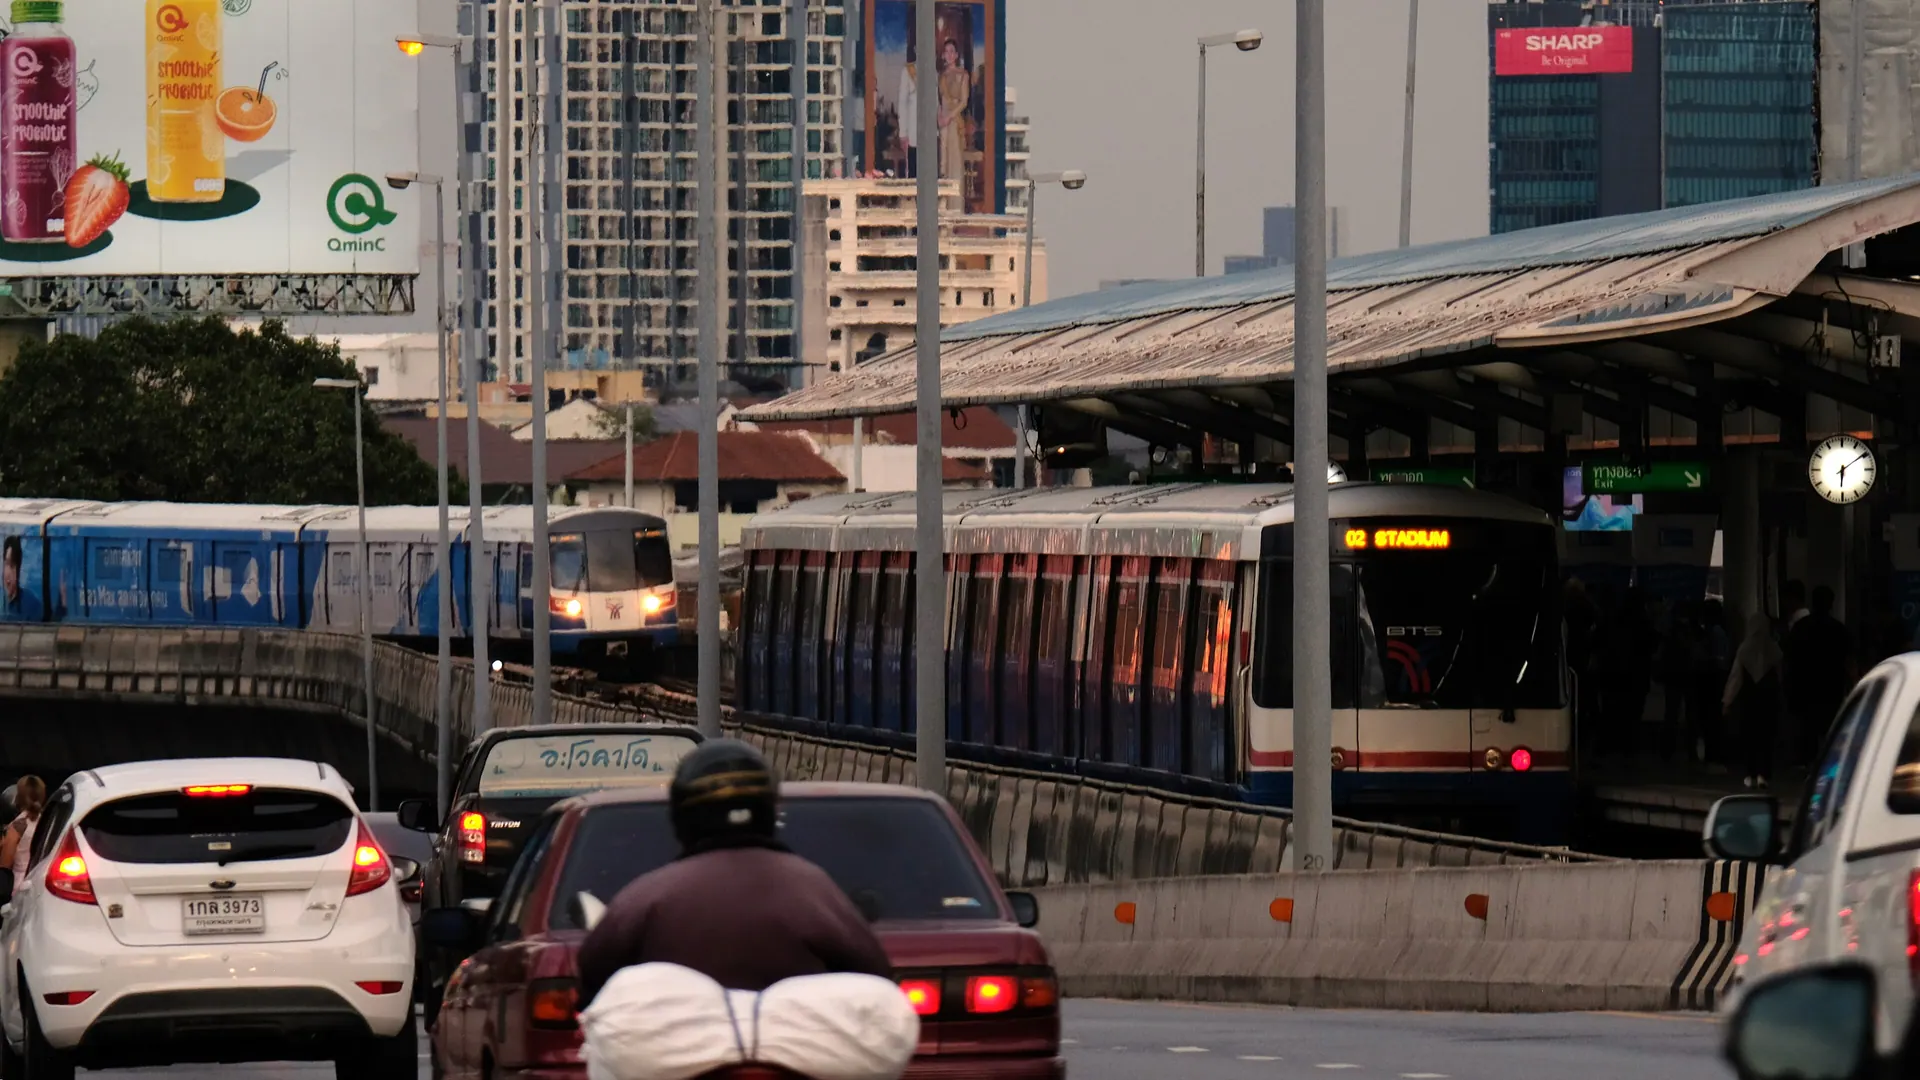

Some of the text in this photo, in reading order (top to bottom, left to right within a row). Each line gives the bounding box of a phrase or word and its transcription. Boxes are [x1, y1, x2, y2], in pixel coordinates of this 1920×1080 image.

[1526, 34, 1604, 51] SHARP
[1541, 55, 1552, 66] Be
[327, 236, 386, 252] QminC
[1594, 478, 1614, 489] Exit
[1345, 530, 1450, 548] 02 STADIUM
[1386, 625, 1443, 636] BTS
[490, 820, 522, 829] TRITON
[1303, 853, 1324, 870] 20
[222, 900, 260, 914] 3973
